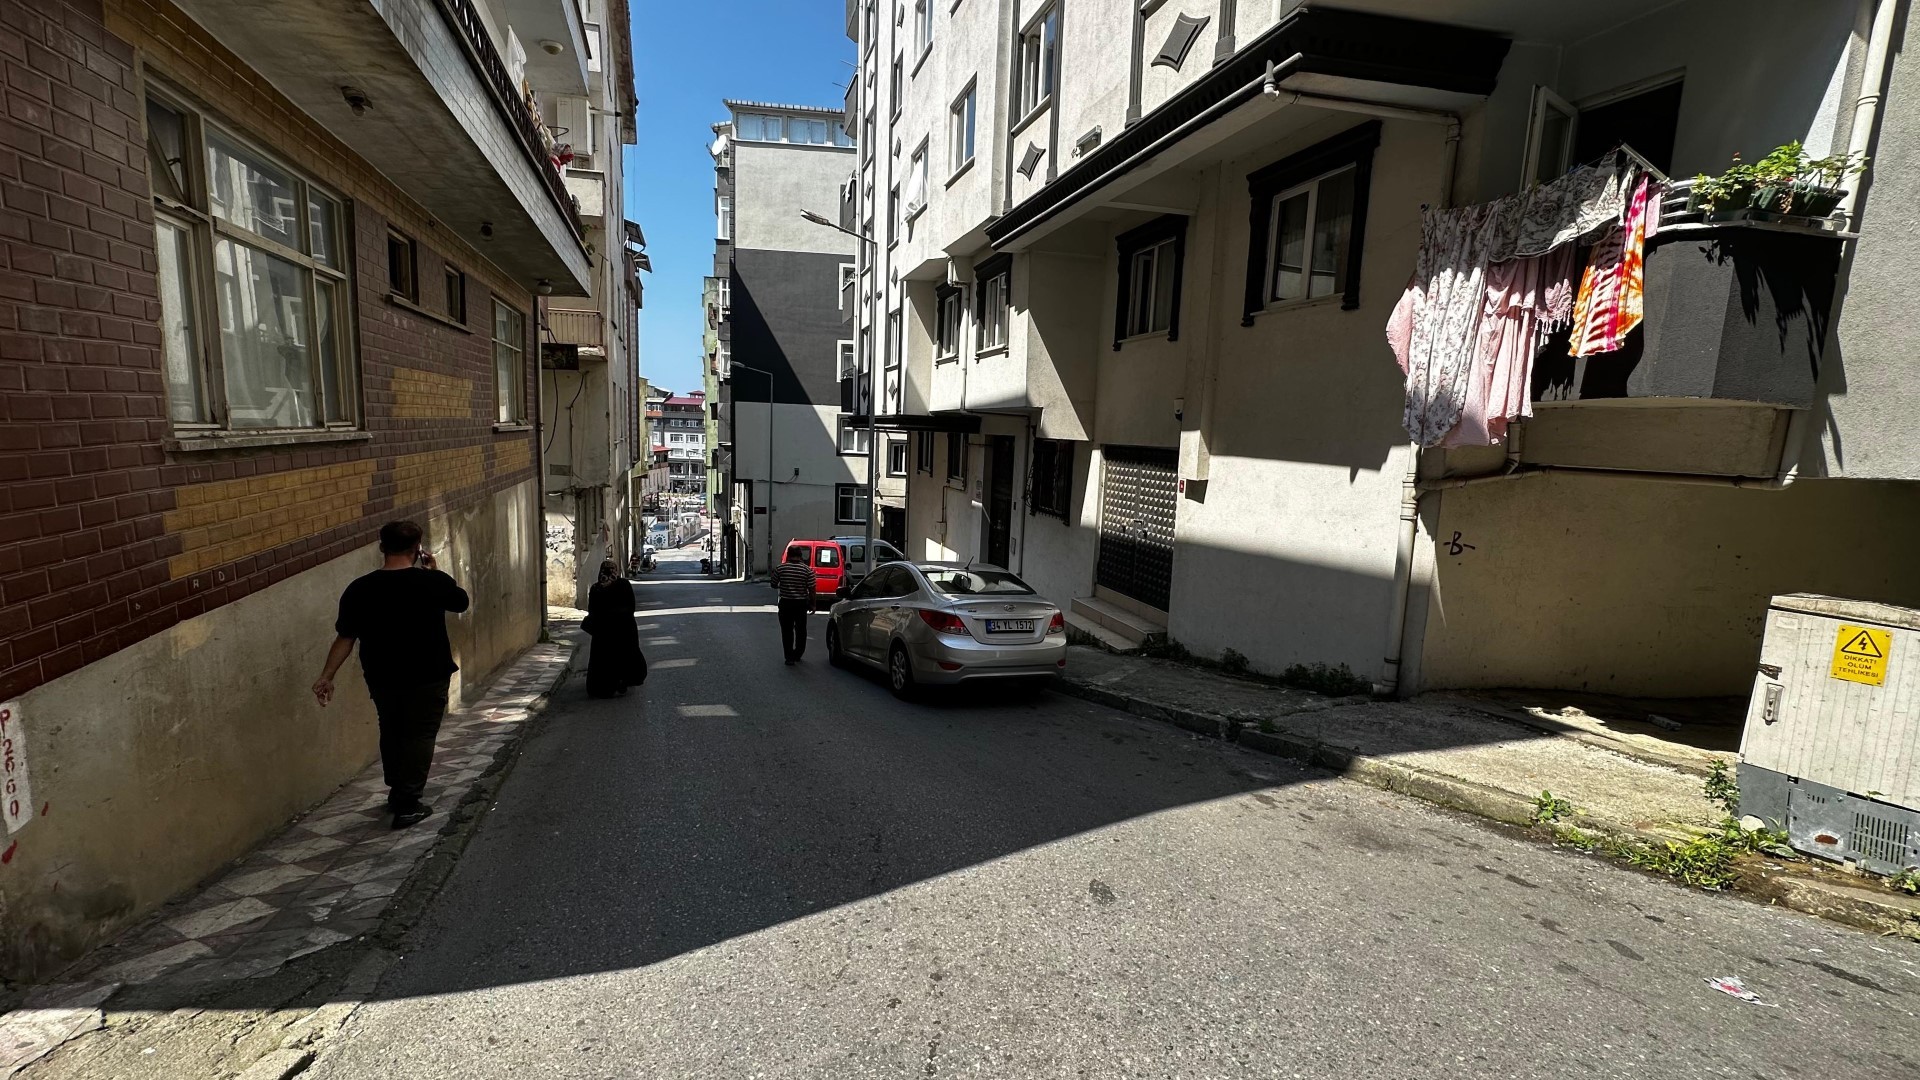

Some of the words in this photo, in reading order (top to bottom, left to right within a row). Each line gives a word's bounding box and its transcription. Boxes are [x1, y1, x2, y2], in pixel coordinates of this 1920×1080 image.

[991, 620, 1000, 630] 34
[1003, 620, 1013, 630] YL
[1015, 620, 1033, 630] 1572
